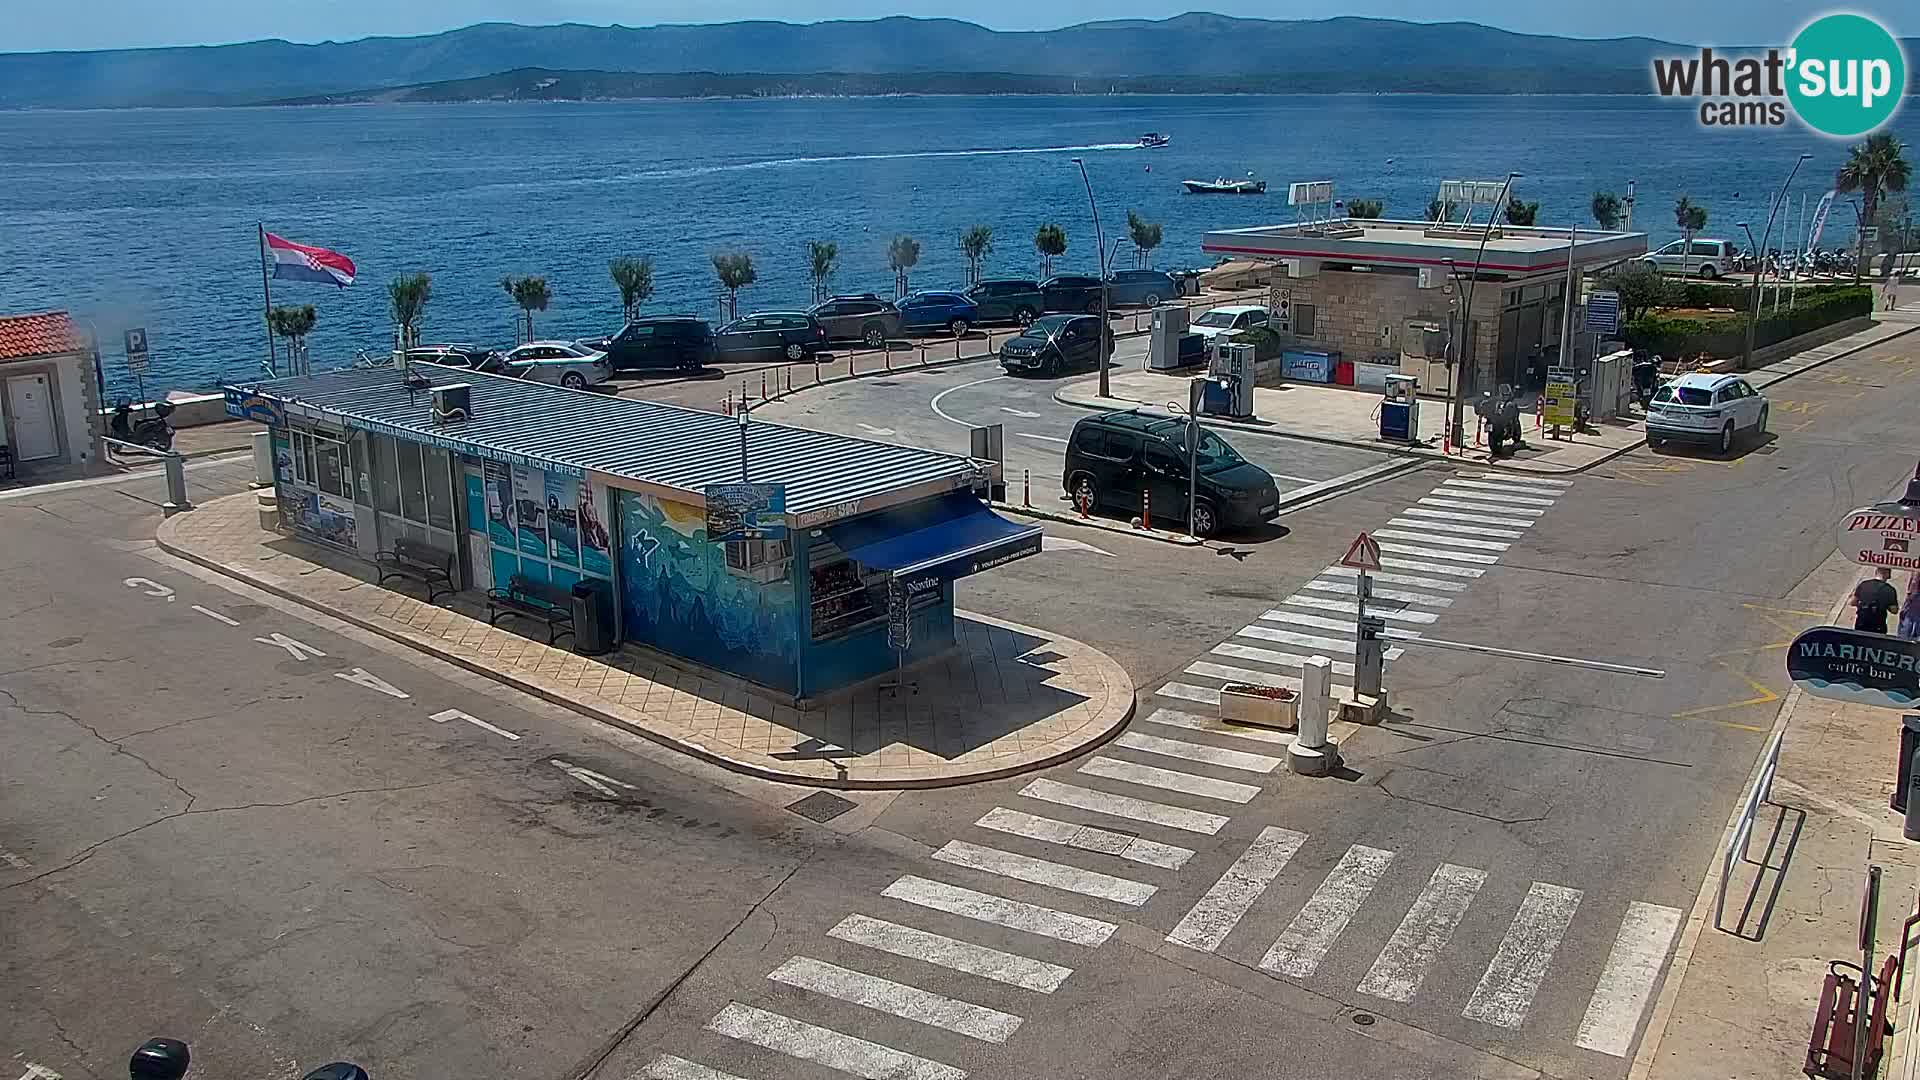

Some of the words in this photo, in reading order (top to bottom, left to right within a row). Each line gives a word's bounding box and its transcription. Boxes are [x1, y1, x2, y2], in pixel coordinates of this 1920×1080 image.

[130, 332, 141, 350] P
[395, 428, 434, 445] AUTOBUSNA
[435, 438, 467, 453] POSTAJA
[477, 446, 492, 458] BUS
[493, 449, 525, 465] STATION
[528, 458, 553, 472] TICKET
[554, 463, 582, 477] OFFICE
[1880, 530, 1916, 541] GRILL
[906, 577, 939, 594] Novine
[1828, 662, 1864, 674] caffe
[1869, 665, 1896, 680] bar
